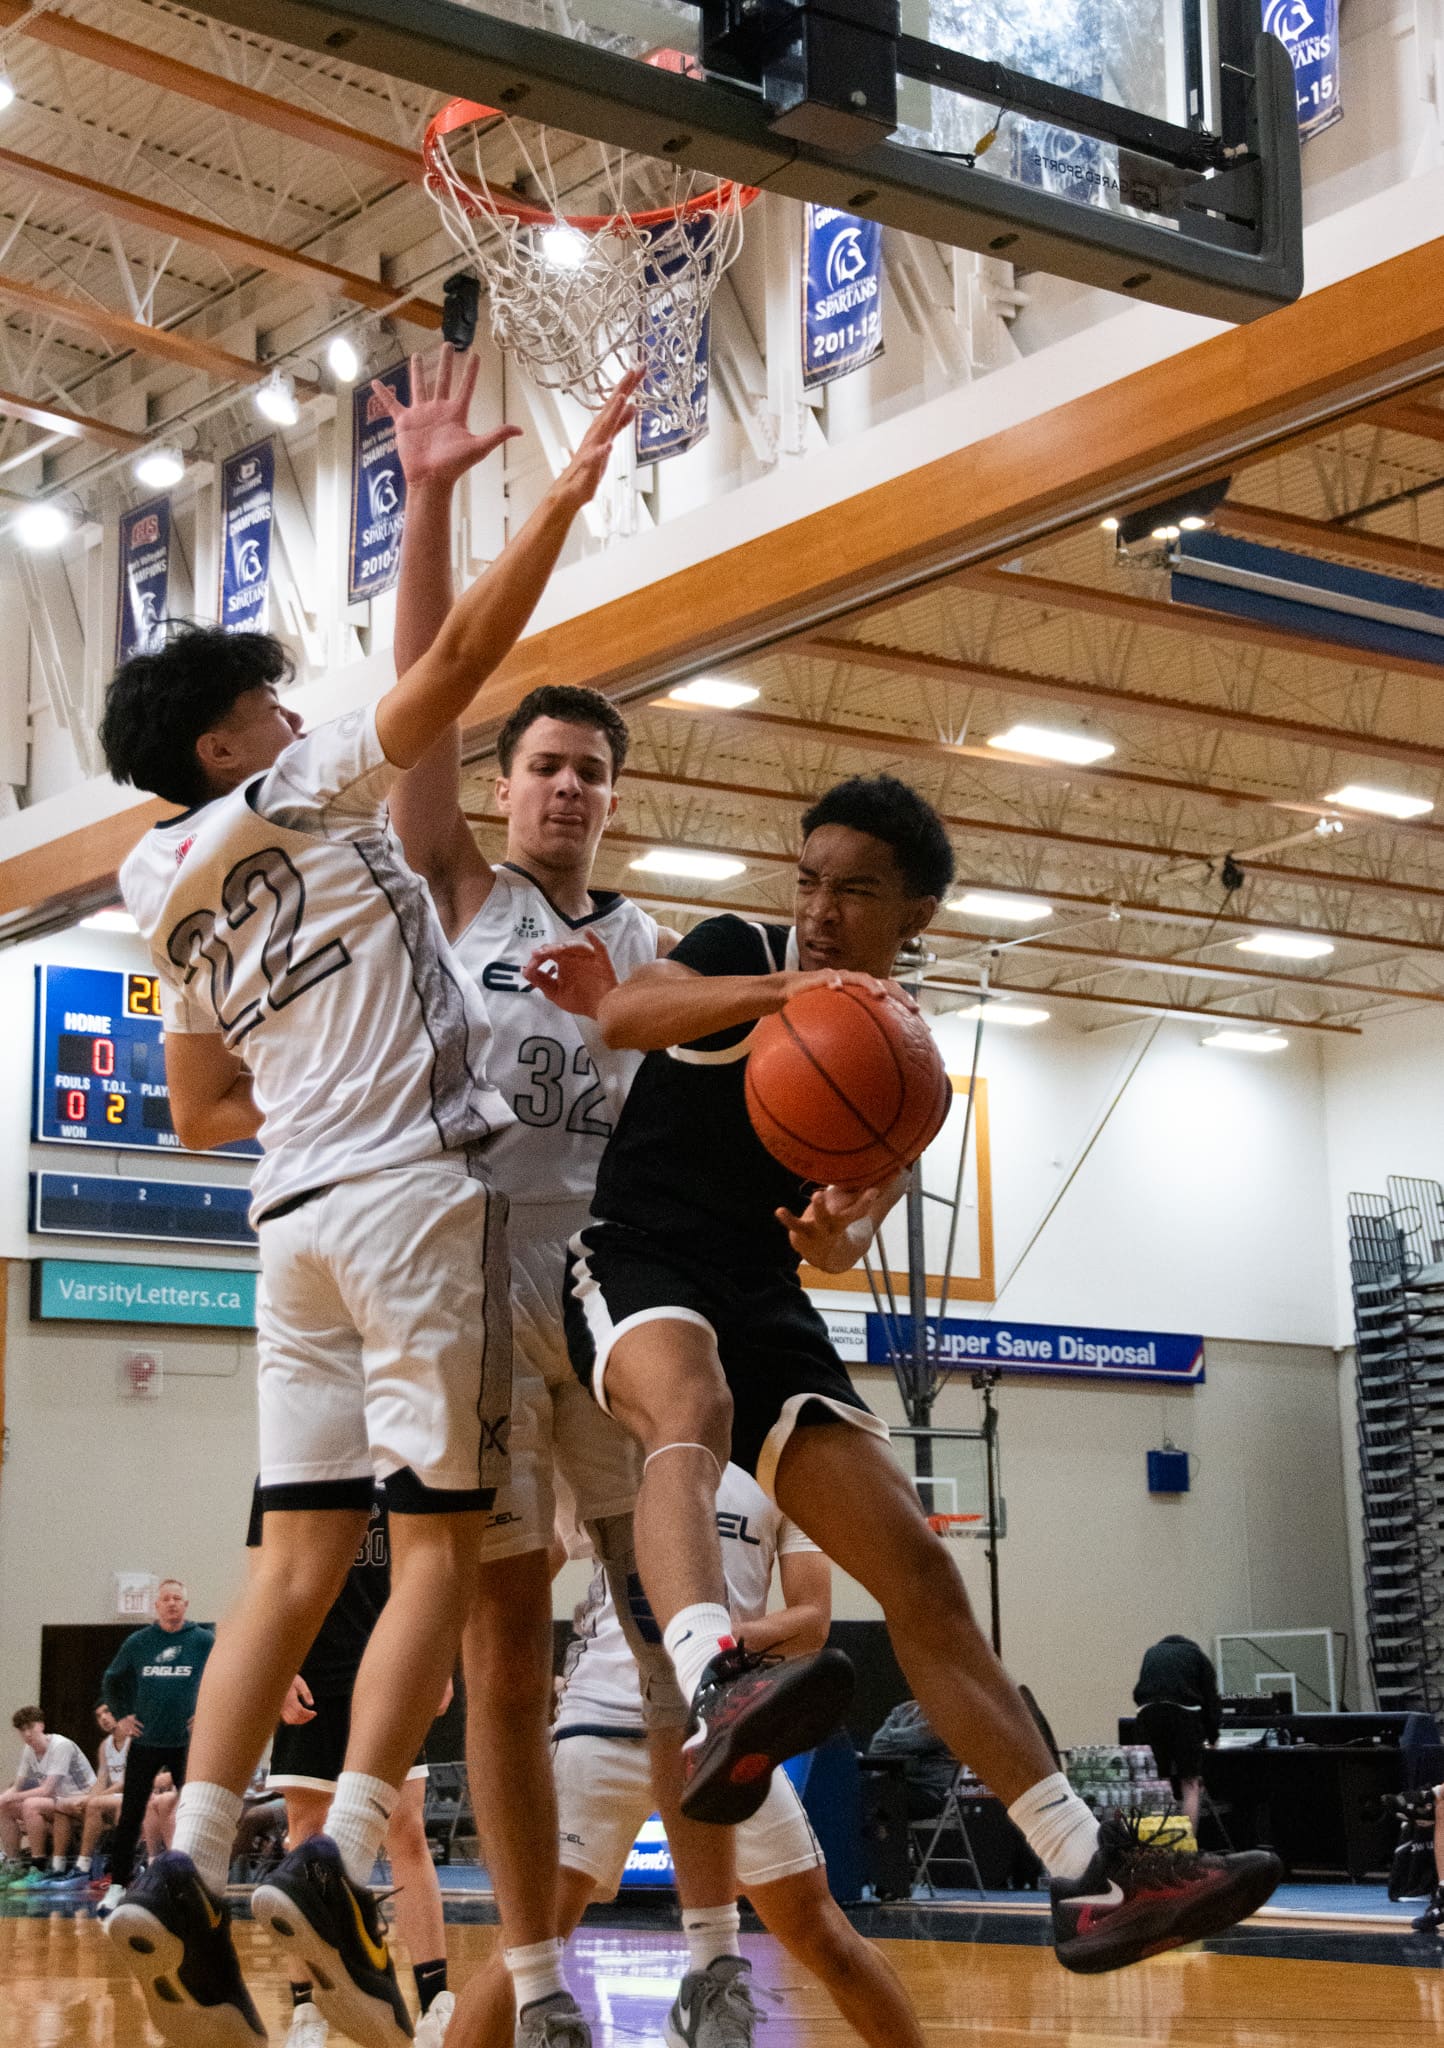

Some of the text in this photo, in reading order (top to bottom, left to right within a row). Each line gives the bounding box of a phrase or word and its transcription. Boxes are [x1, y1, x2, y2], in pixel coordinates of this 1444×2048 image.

[1290, 33, 1331, 69] TANS
[815, 279, 877, 321] SPARTANS
[813, 311, 878, 358] 2011-12
[167, 847, 352, 1050] 22
[64, 1012, 112, 1035] HOME
[92, 1038, 114, 1076] 0
[55, 1074, 169, 1097] FOULS T.O.L. PLAY
[513, 1035, 613, 1139] 32
[67, 1090, 125, 1124] 0 2
[61, 1125, 180, 1146] WON MAT
[72, 1184, 212, 1206] 1 2 3
[59, 1278, 241, 1308] VarsityLetters.ca
[926, 1325, 1156, 1368] Super Save Disposal
[142, 1665, 193, 1677] EAGLES
[625, 1849, 670, 1871] Events
